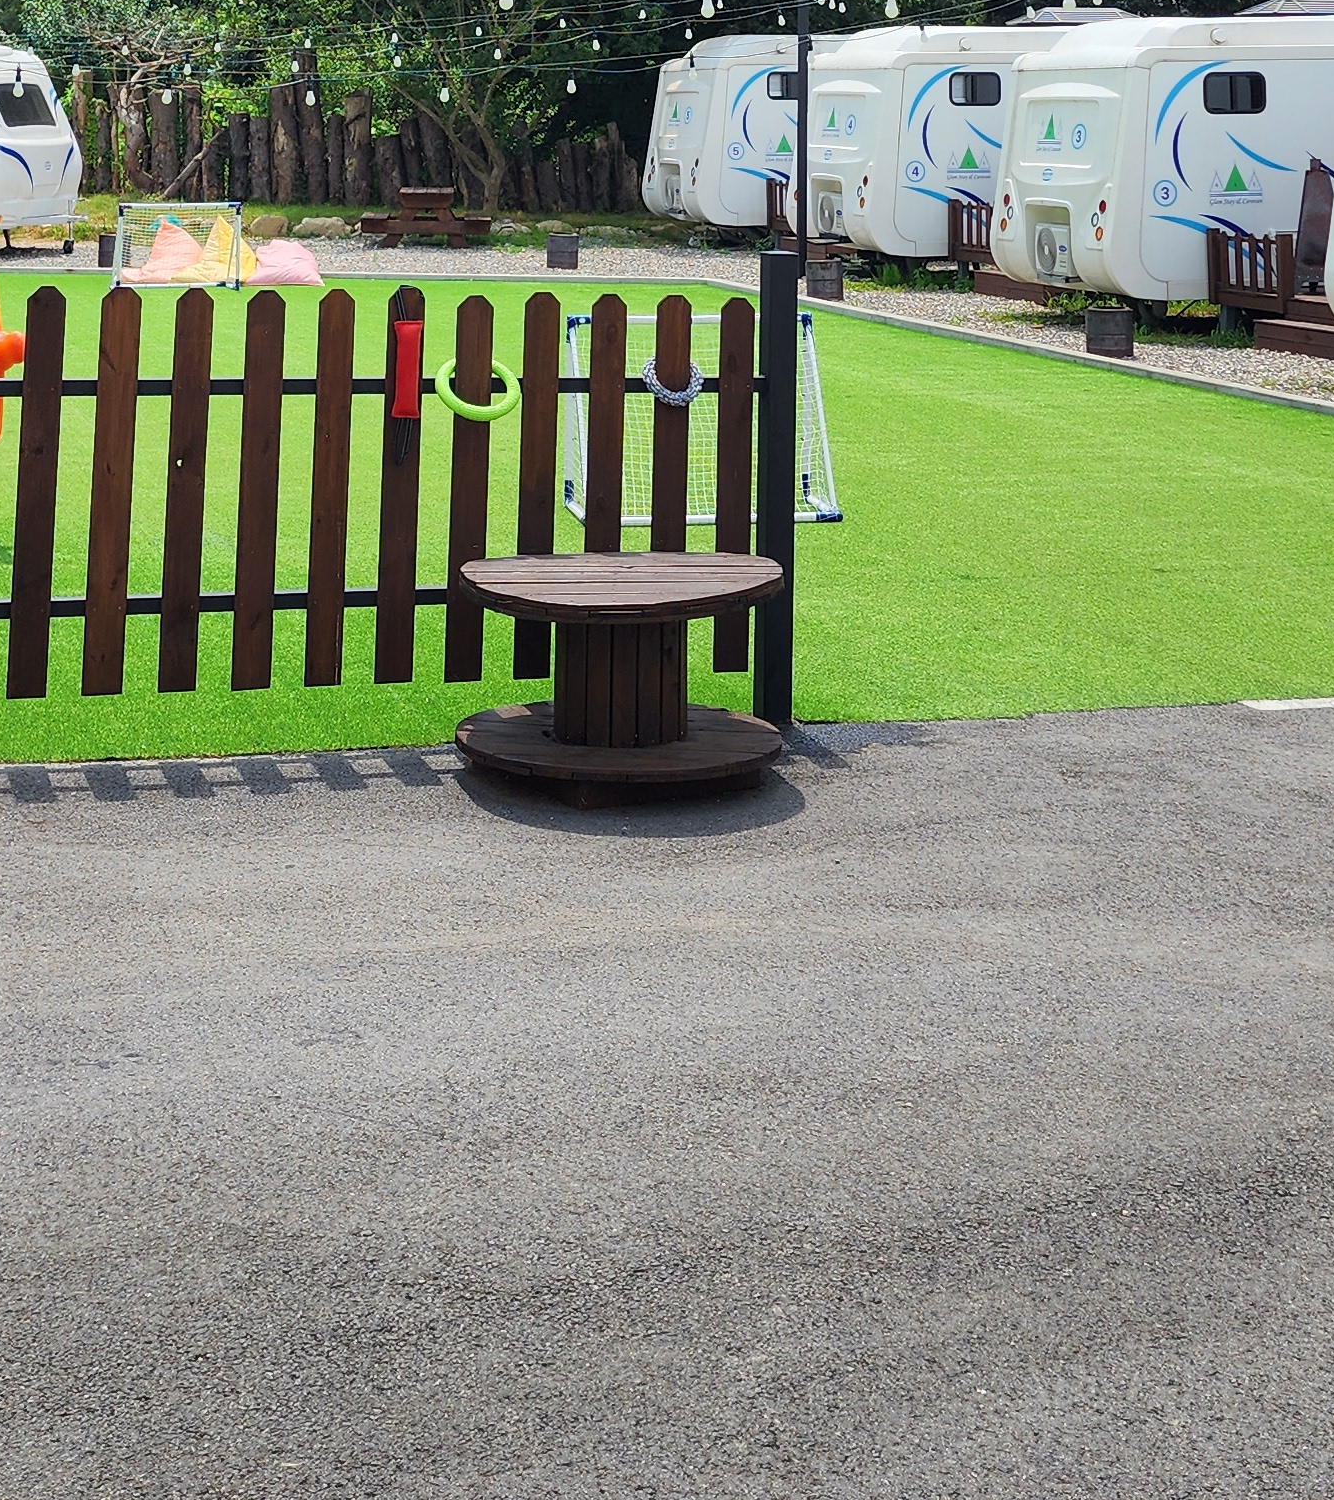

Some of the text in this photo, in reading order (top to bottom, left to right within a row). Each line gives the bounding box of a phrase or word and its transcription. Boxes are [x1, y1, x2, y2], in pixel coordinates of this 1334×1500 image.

[848, 119, 853, 130] 4
[1075, 129, 1082, 143] 3
[733, 146, 740, 156] 5
[911, 166, 920, 177] 4
[1160, 186, 1170, 200] 3
